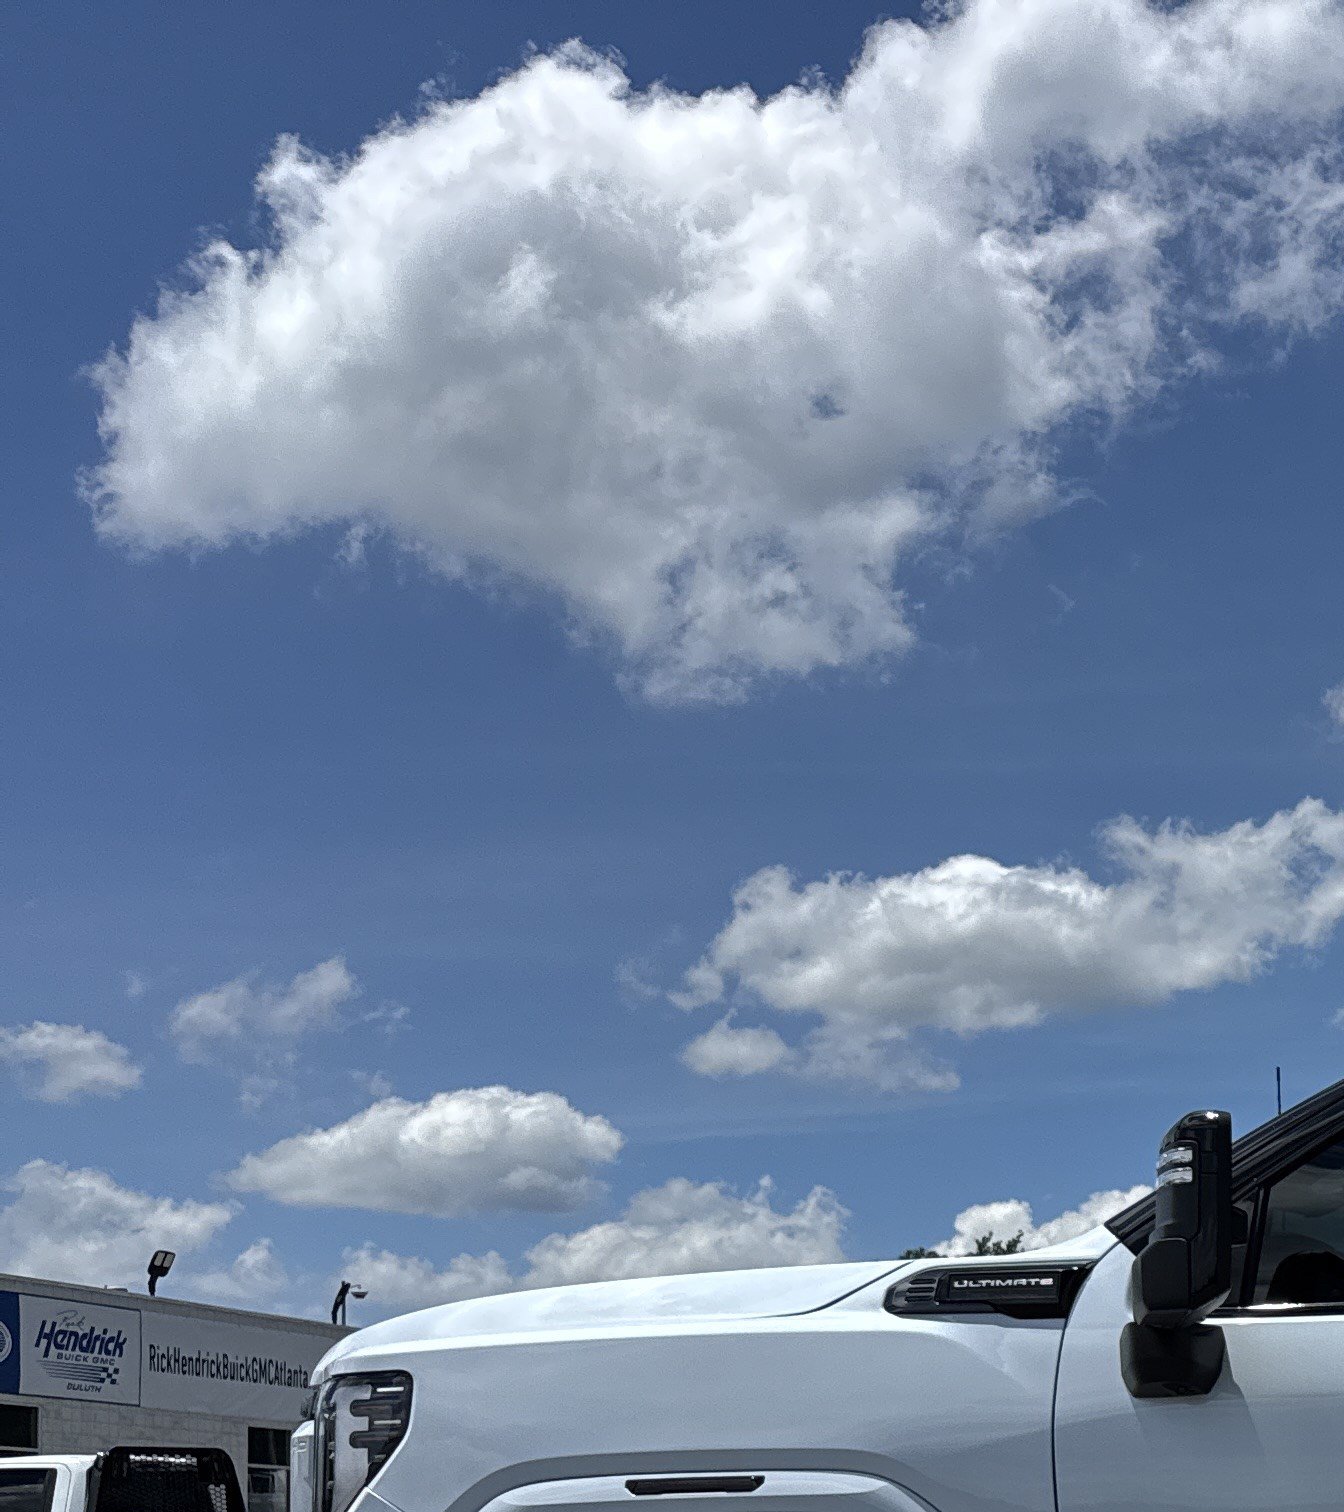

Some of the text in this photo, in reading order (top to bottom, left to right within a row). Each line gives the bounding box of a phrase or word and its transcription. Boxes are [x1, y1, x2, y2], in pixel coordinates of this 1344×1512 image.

[953, 1278, 1054, 1288] ULTIMATE
[34, 1320, 127, 1358] Hendrick
[56, 1351, 116, 1367] BUICK GMC
[66, 1382, 103, 1393] DULUTH
